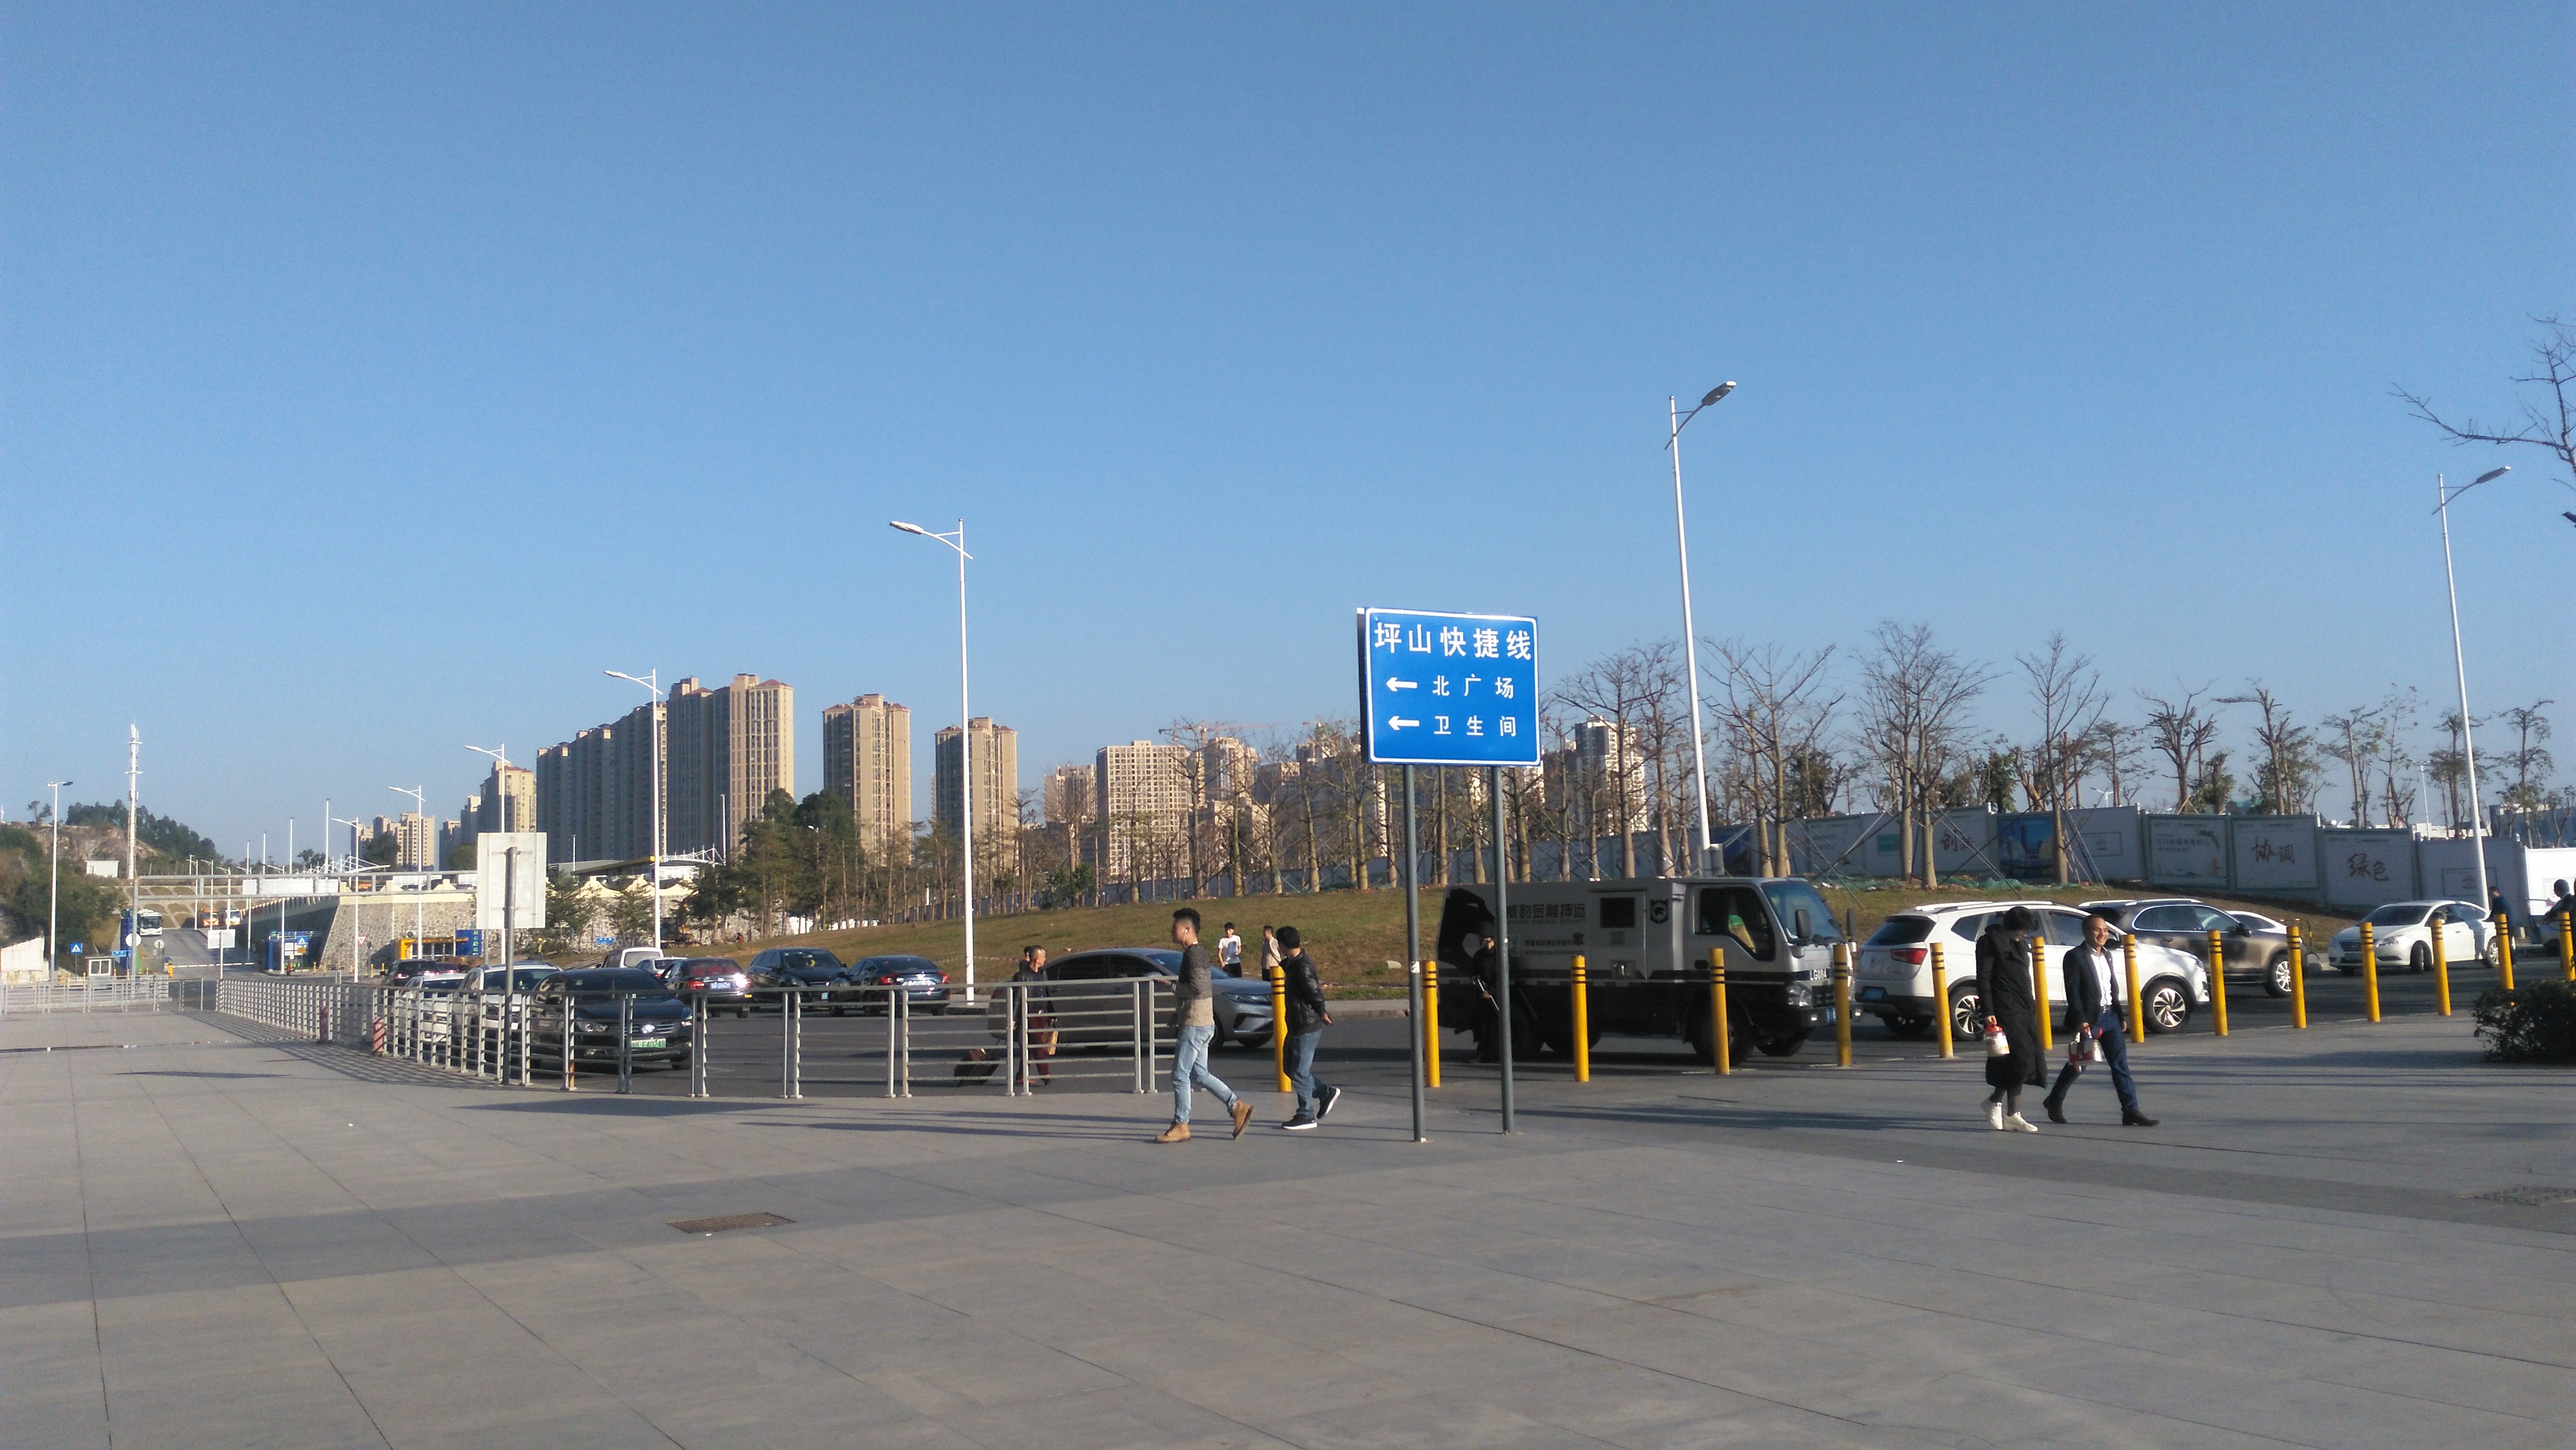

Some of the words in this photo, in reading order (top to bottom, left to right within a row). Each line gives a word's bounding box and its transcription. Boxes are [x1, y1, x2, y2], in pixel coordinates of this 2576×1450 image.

[1374, 622, 1532, 660] 坪山快捷线
[1432, 674, 1514, 699] 北广场
[1434, 715, 1516, 737] 卫生间
[2252, 836, 2295, 863] 协调
[2348, 853, 2389, 881] 绿色
[1810, 969, 1827, 980] LG084
